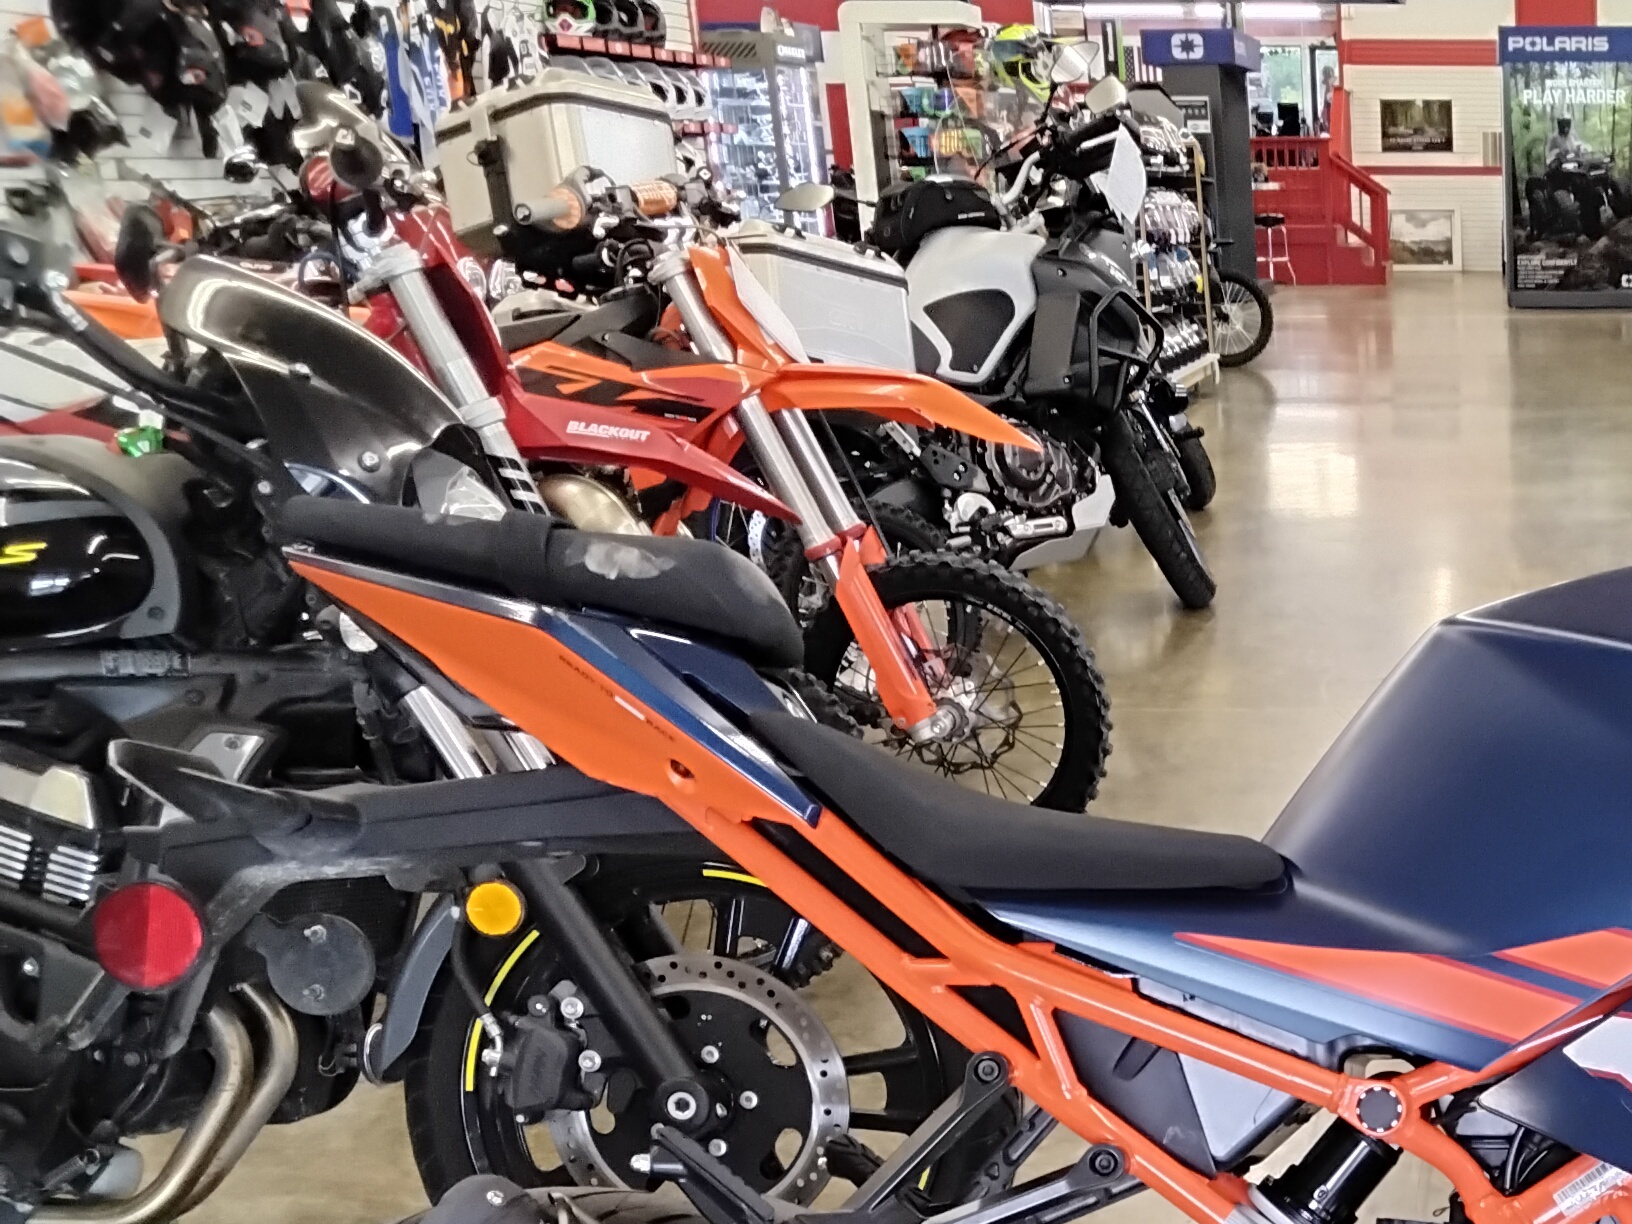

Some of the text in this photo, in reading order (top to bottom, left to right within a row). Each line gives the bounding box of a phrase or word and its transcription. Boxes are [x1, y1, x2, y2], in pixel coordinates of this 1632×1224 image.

[1507, 36, 1609, 52] POLARIS
[1522, 88, 1627, 105] PLAY HARDER
[566, 420, 651, 443] BLACKOUT
